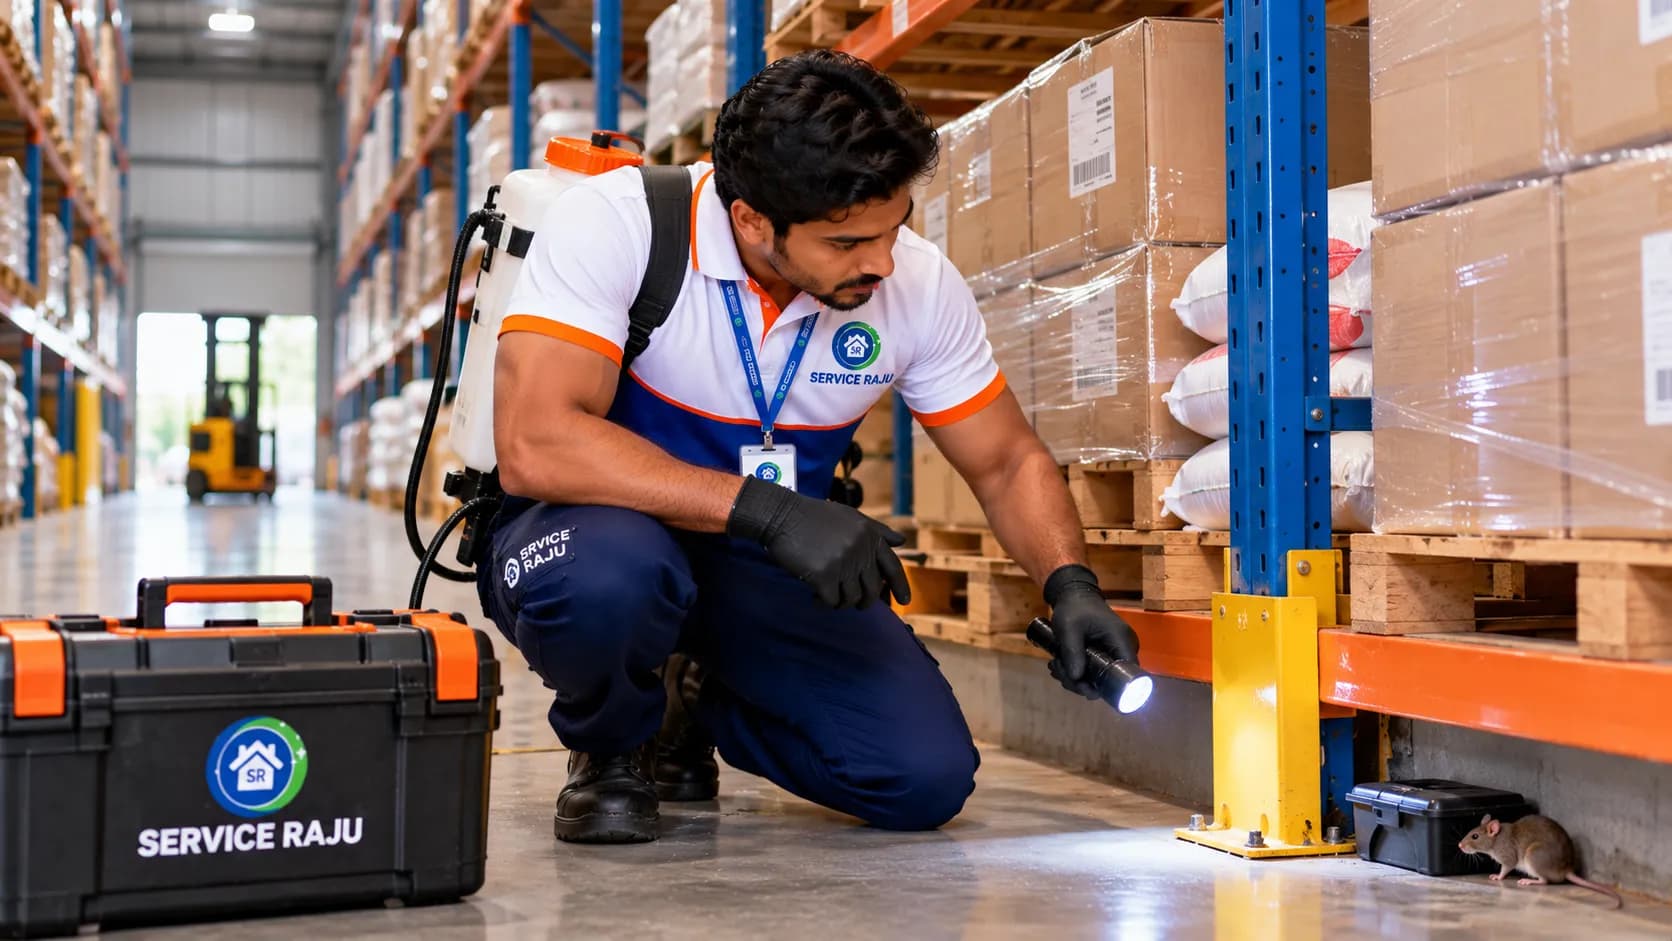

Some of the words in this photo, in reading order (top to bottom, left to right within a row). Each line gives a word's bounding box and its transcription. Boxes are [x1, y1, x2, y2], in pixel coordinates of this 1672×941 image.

[850, 346, 862, 355] SR
[809, 372, 861, 385] SERVICE
[863, 373, 894, 385] RAJU
[523, 543, 566, 573] RAJU
[246, 768, 266, 783] SR
[137, 822, 276, 858] SERVICE
[282, 817, 363, 848] RAJU
